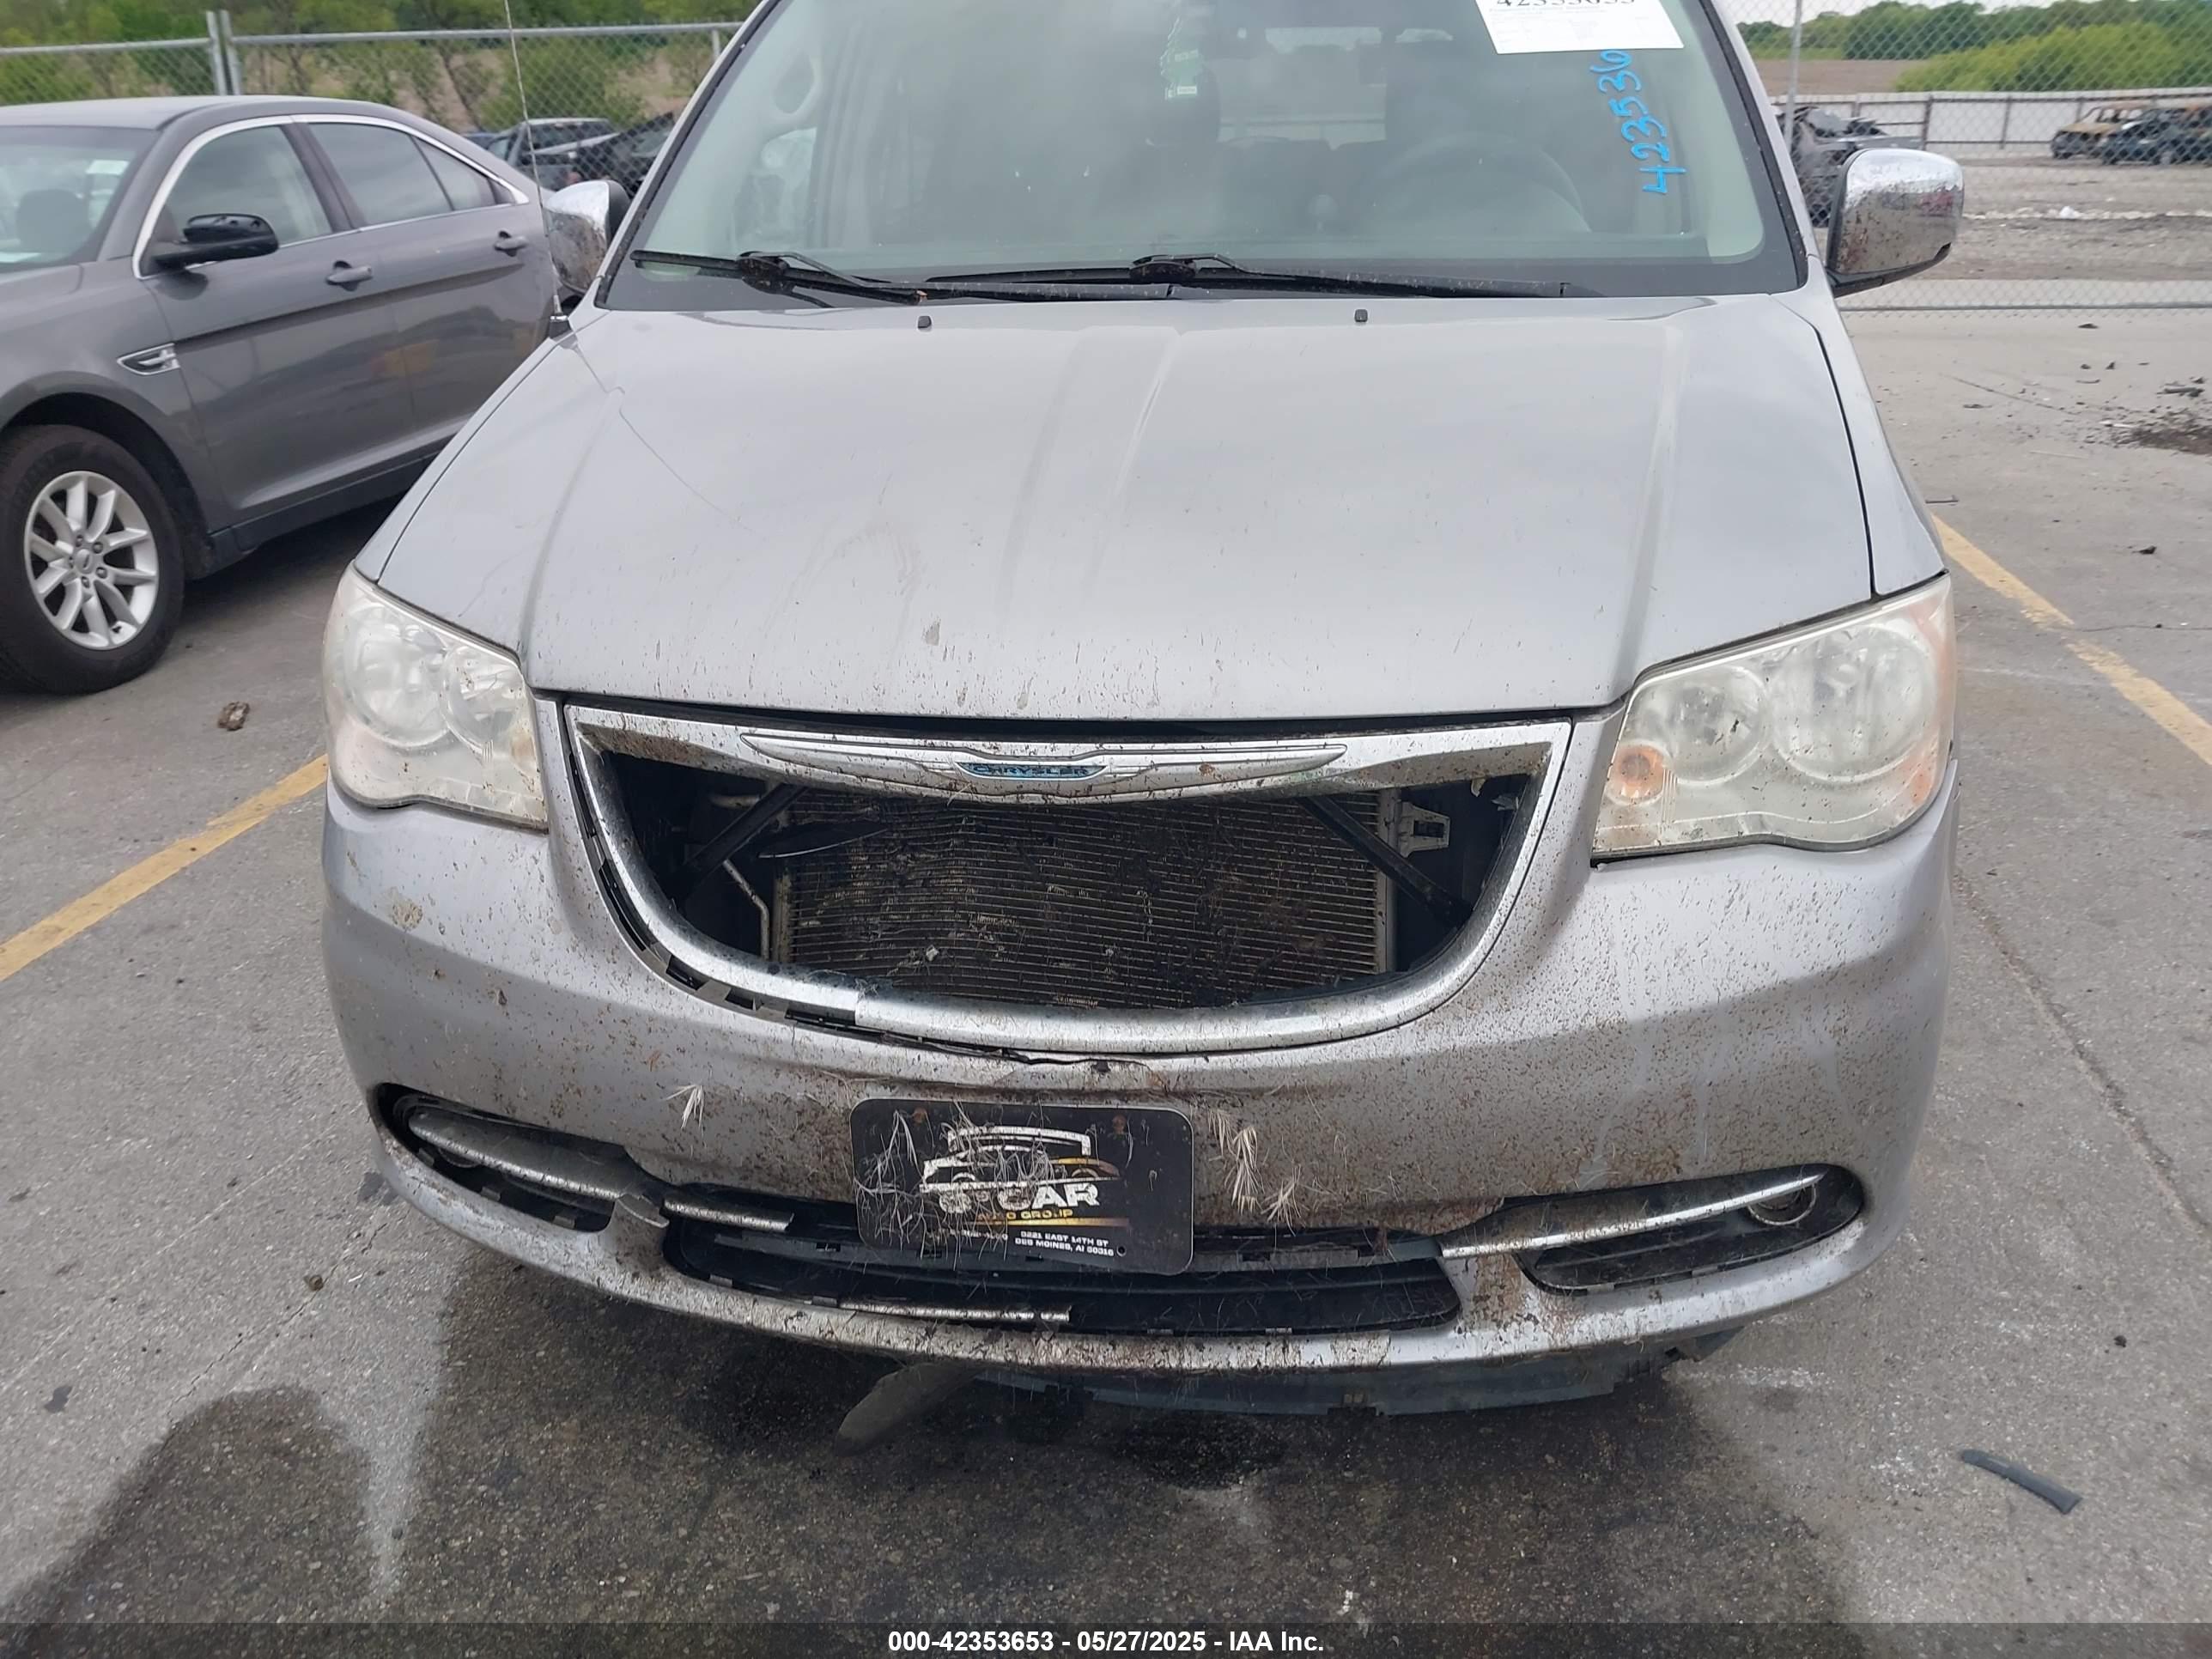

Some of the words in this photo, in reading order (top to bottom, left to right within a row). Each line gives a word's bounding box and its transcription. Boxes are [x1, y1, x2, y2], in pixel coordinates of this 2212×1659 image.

[973, 766, 1088, 776] CHRYSLER
[1020, 1208, 1073, 1219] GROUP
[1015, 1237, 1033, 1246] DES
[1036, 1239, 1073, 1252] MOINES,
[1044, 1233, 1069, 1243] EAST
[1071, 1236, 1094, 1246] 14TH
[1096, 1239, 1109, 1248] ST
